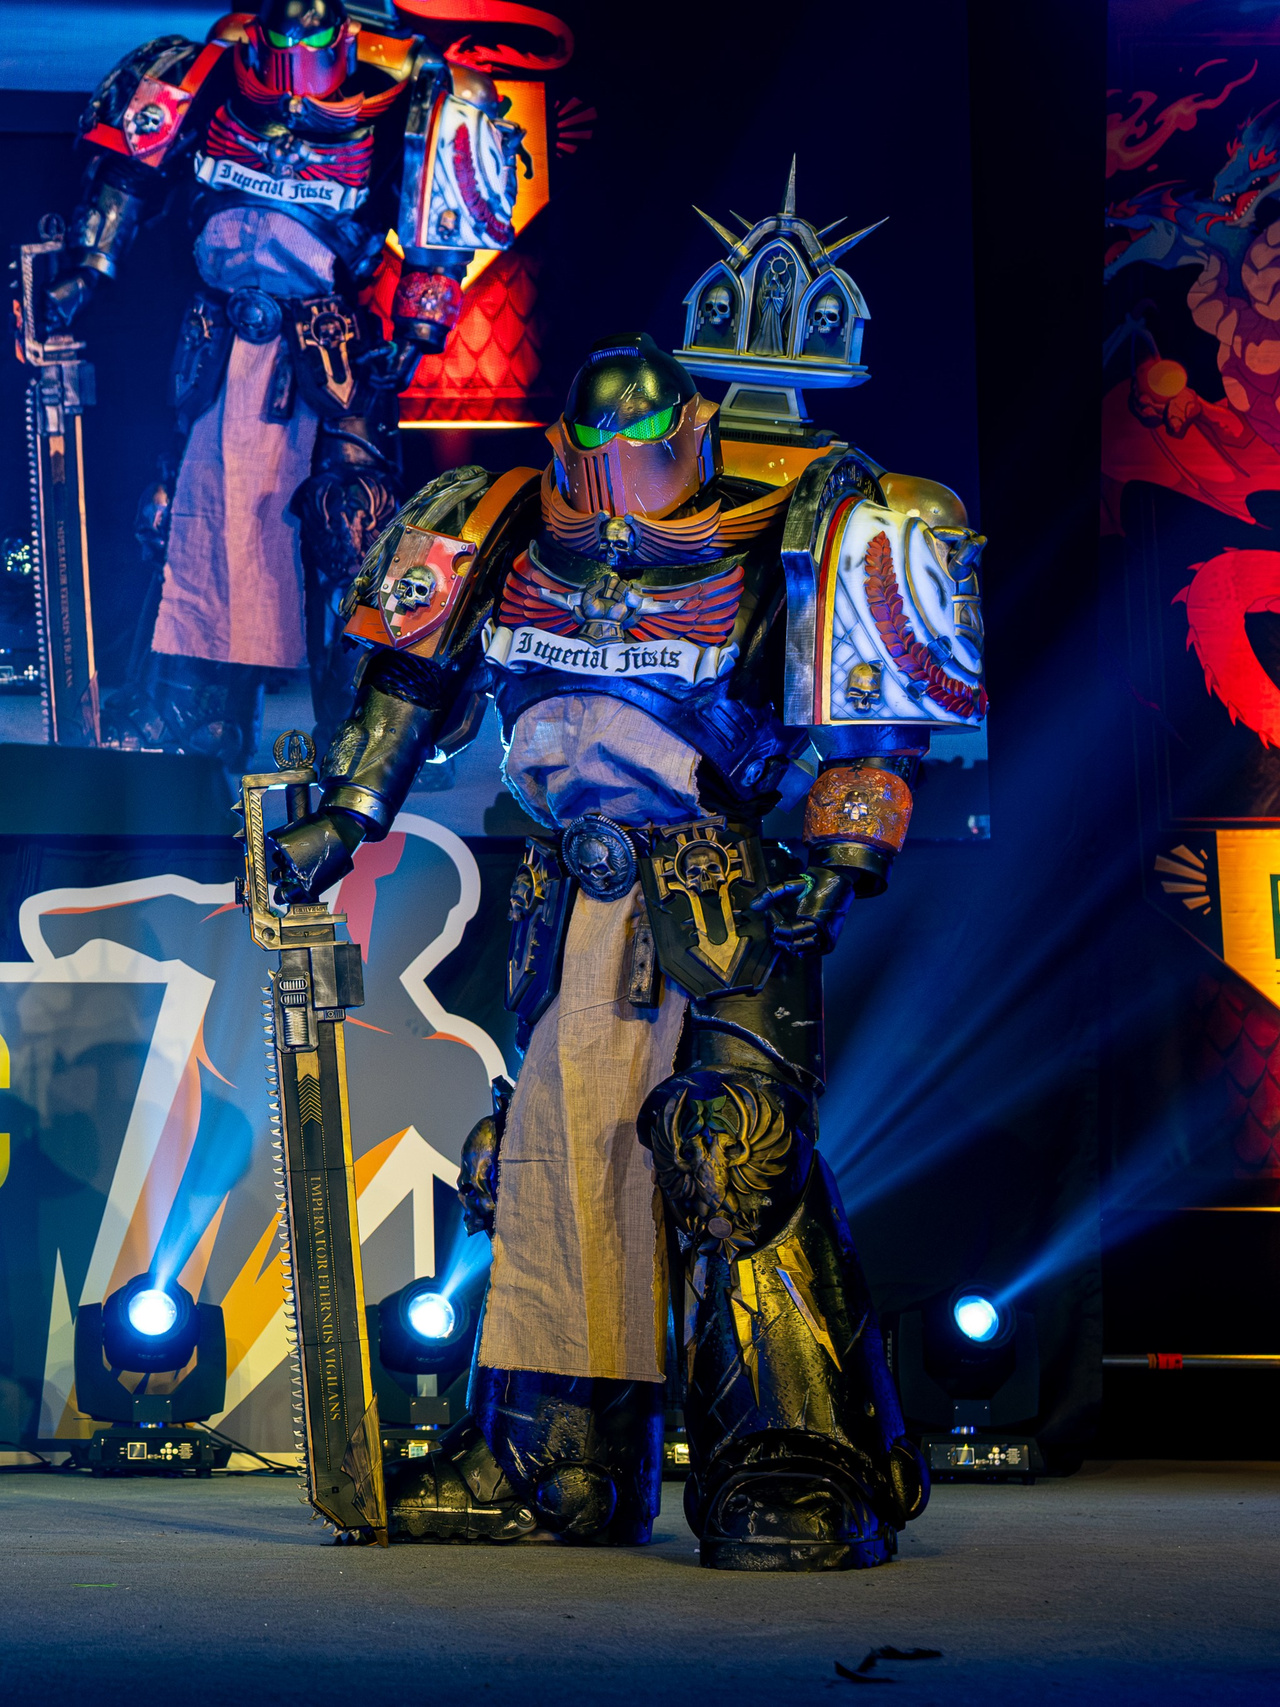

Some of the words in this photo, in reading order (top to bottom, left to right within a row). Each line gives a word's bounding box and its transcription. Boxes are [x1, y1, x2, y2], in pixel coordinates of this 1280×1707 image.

[310, 1176, 328, 1270] IMPERATOR
[317, 1274, 335, 1344] ETERNUS
[324, 1347, 341, 1422] VIGILANS
